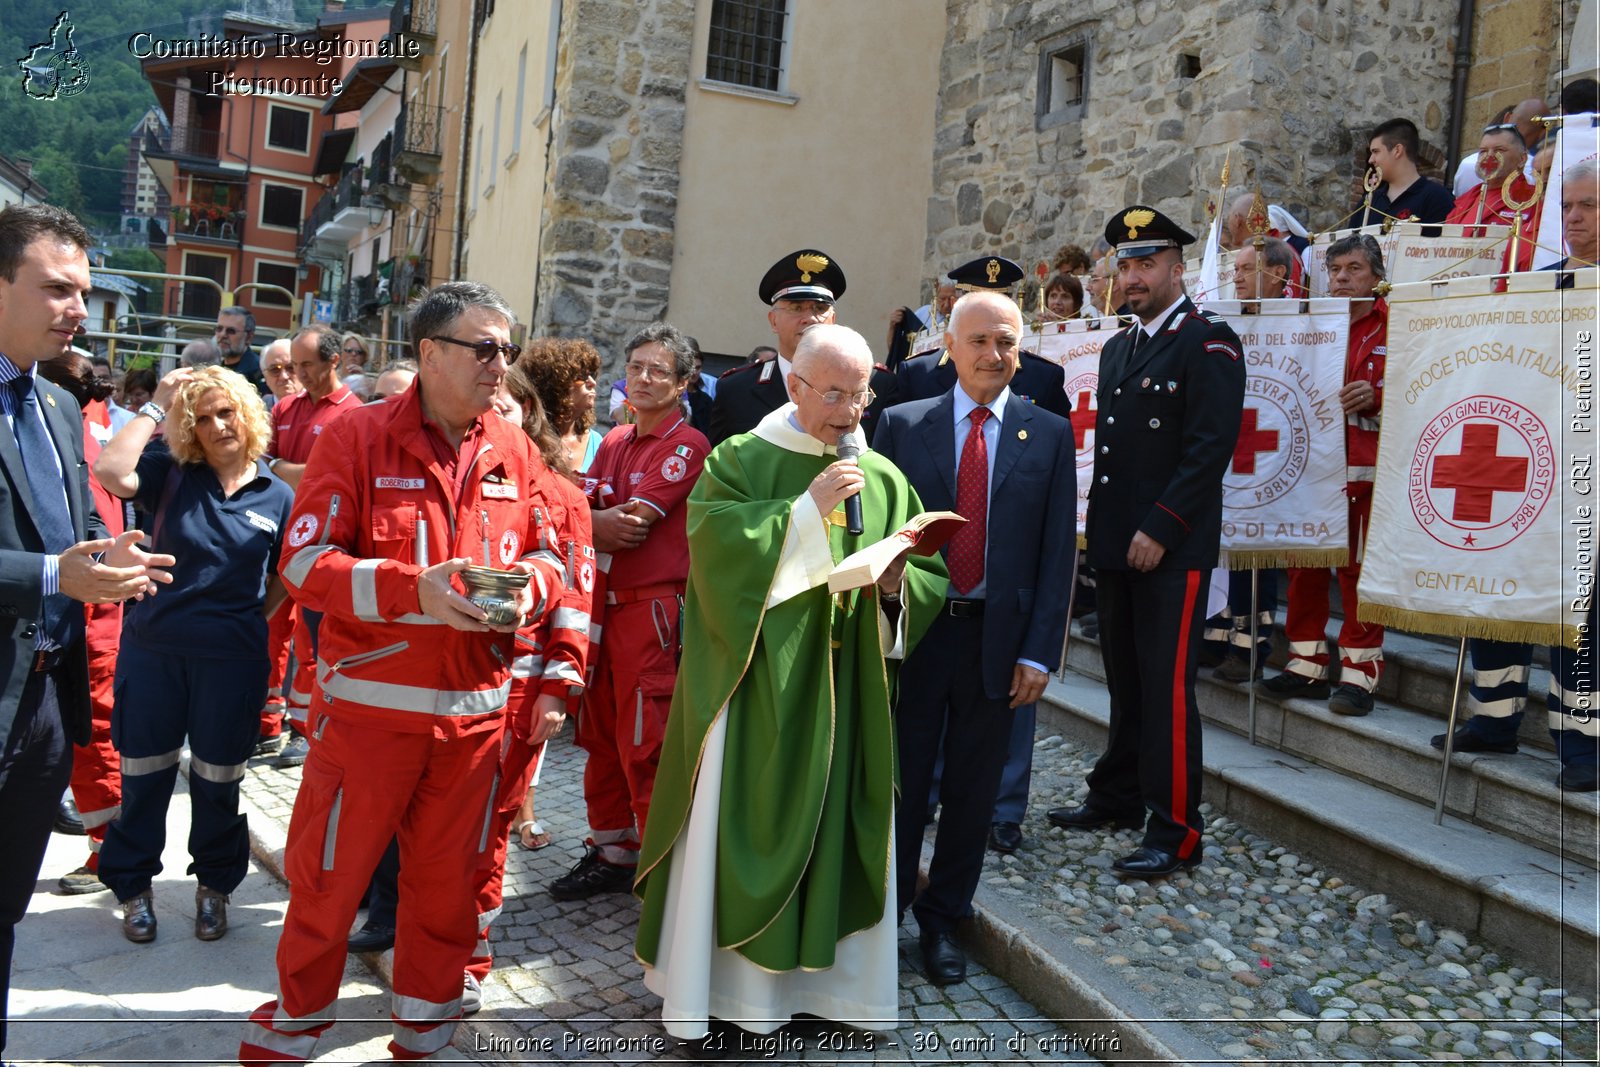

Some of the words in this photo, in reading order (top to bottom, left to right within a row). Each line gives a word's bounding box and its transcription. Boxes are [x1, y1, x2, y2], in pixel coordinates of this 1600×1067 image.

[1405, 247, 1429, 258] CORPO
[1478, 249, 1496, 260] DEL
[1409, 318, 1442, 332] CORPO
[1444, 311, 1504, 329] VOLONTARI
[1506, 311, 1528, 325] DEL
[1531, 306, 1596, 324] SOCCORSO
[1266, 333, 1286, 346] DEL
[1405, 356, 1454, 405] CROCE
[1455, 342, 1515, 369] ROSSA
[1278, 355, 1334, 431] ITALIANA
[1440, 412, 1454, 428] DI
[1455, 401, 1521, 423] GINEVRA
[1520, 417, 1540, 437] 22
[1287, 427, 1306, 478] AGOSTO
[1412, 425, 1442, 525] CONVENZIONE
[1533, 436, 1551, 500] AGOSTO
[380, 478, 410, 488] ROBERTO
[1255, 477, 1289, 502] 1864
[1245, 523, 1265, 537] DI
[1275, 522, 1331, 538] ALBA
[1511, 503, 1536, 532] 1864
[1415, 570, 1518, 596] CENTALLO
